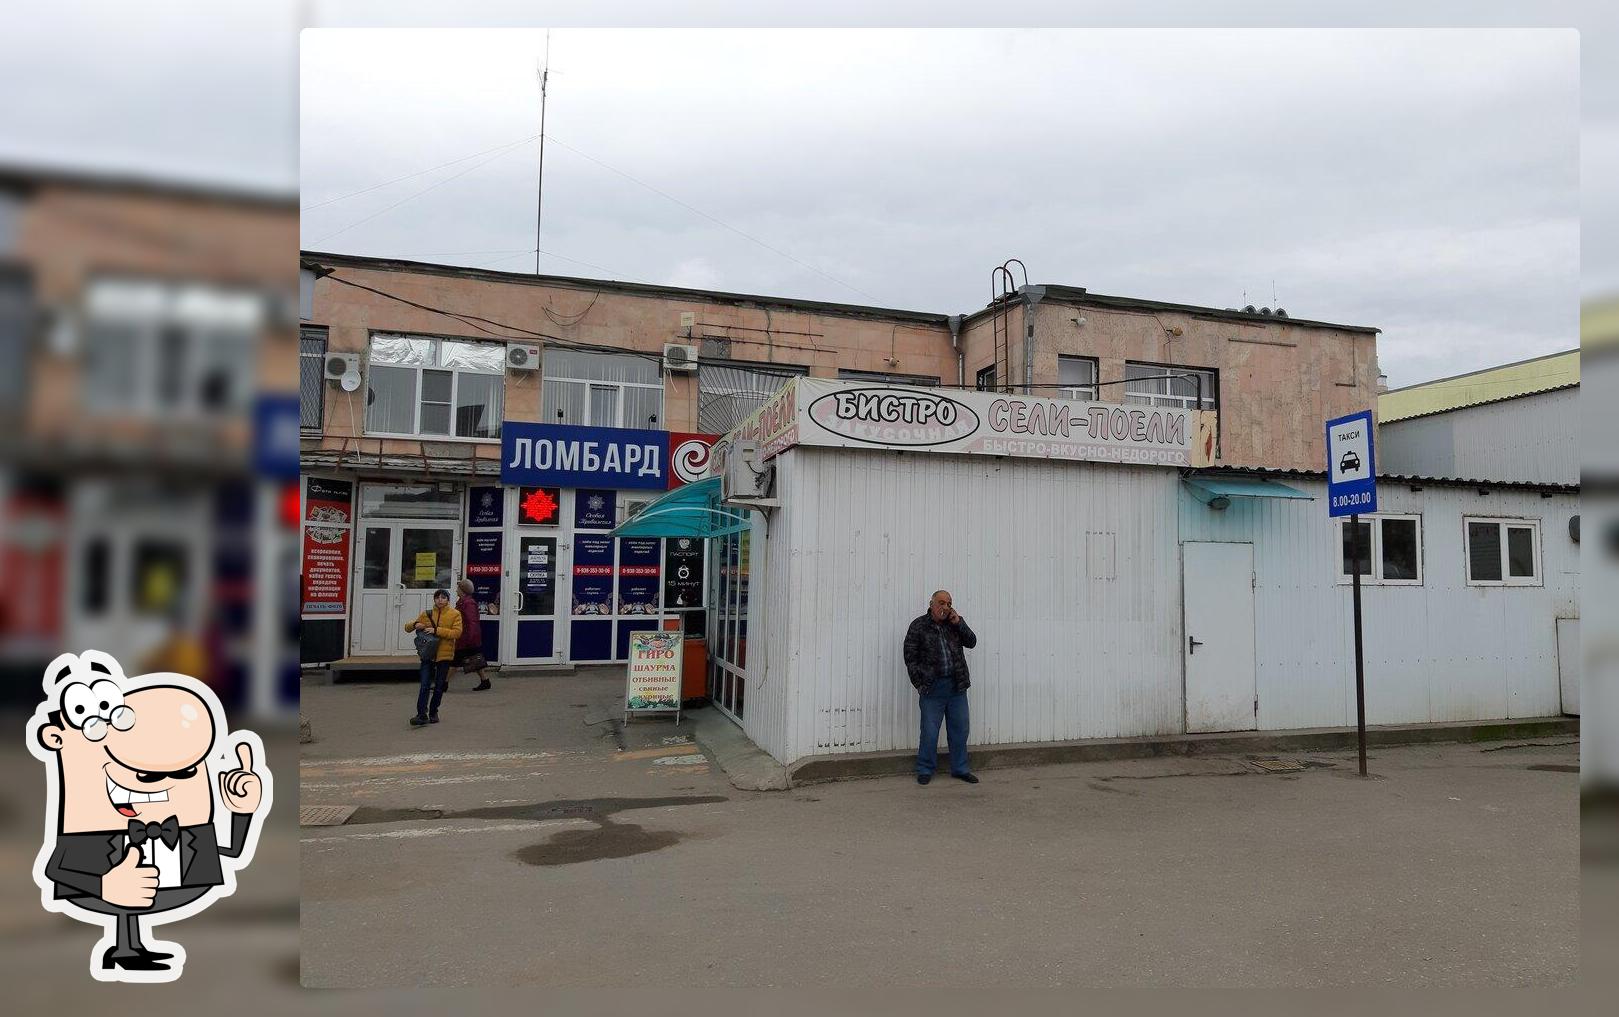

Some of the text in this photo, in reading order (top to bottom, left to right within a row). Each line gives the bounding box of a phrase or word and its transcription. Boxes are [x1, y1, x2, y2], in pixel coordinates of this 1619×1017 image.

[833, 392, 957, 426] БИСТРО
[988, 399, 1185, 446] СЕЛИ-ПОЕЛИ
[1338, 430, 1360, 442] ТАКСИ
[509, 438, 661, 478] ЛОМБАРД
[983, 439, 1185, 463] БЫСТРО-ВКУСНО-НЕДОРОГО
[1333, 491, 1371, 508] 8.00-20.00
[638, 649, 674, 659] ГИРО
[633, 664, 676, 672] ШАУРМА
